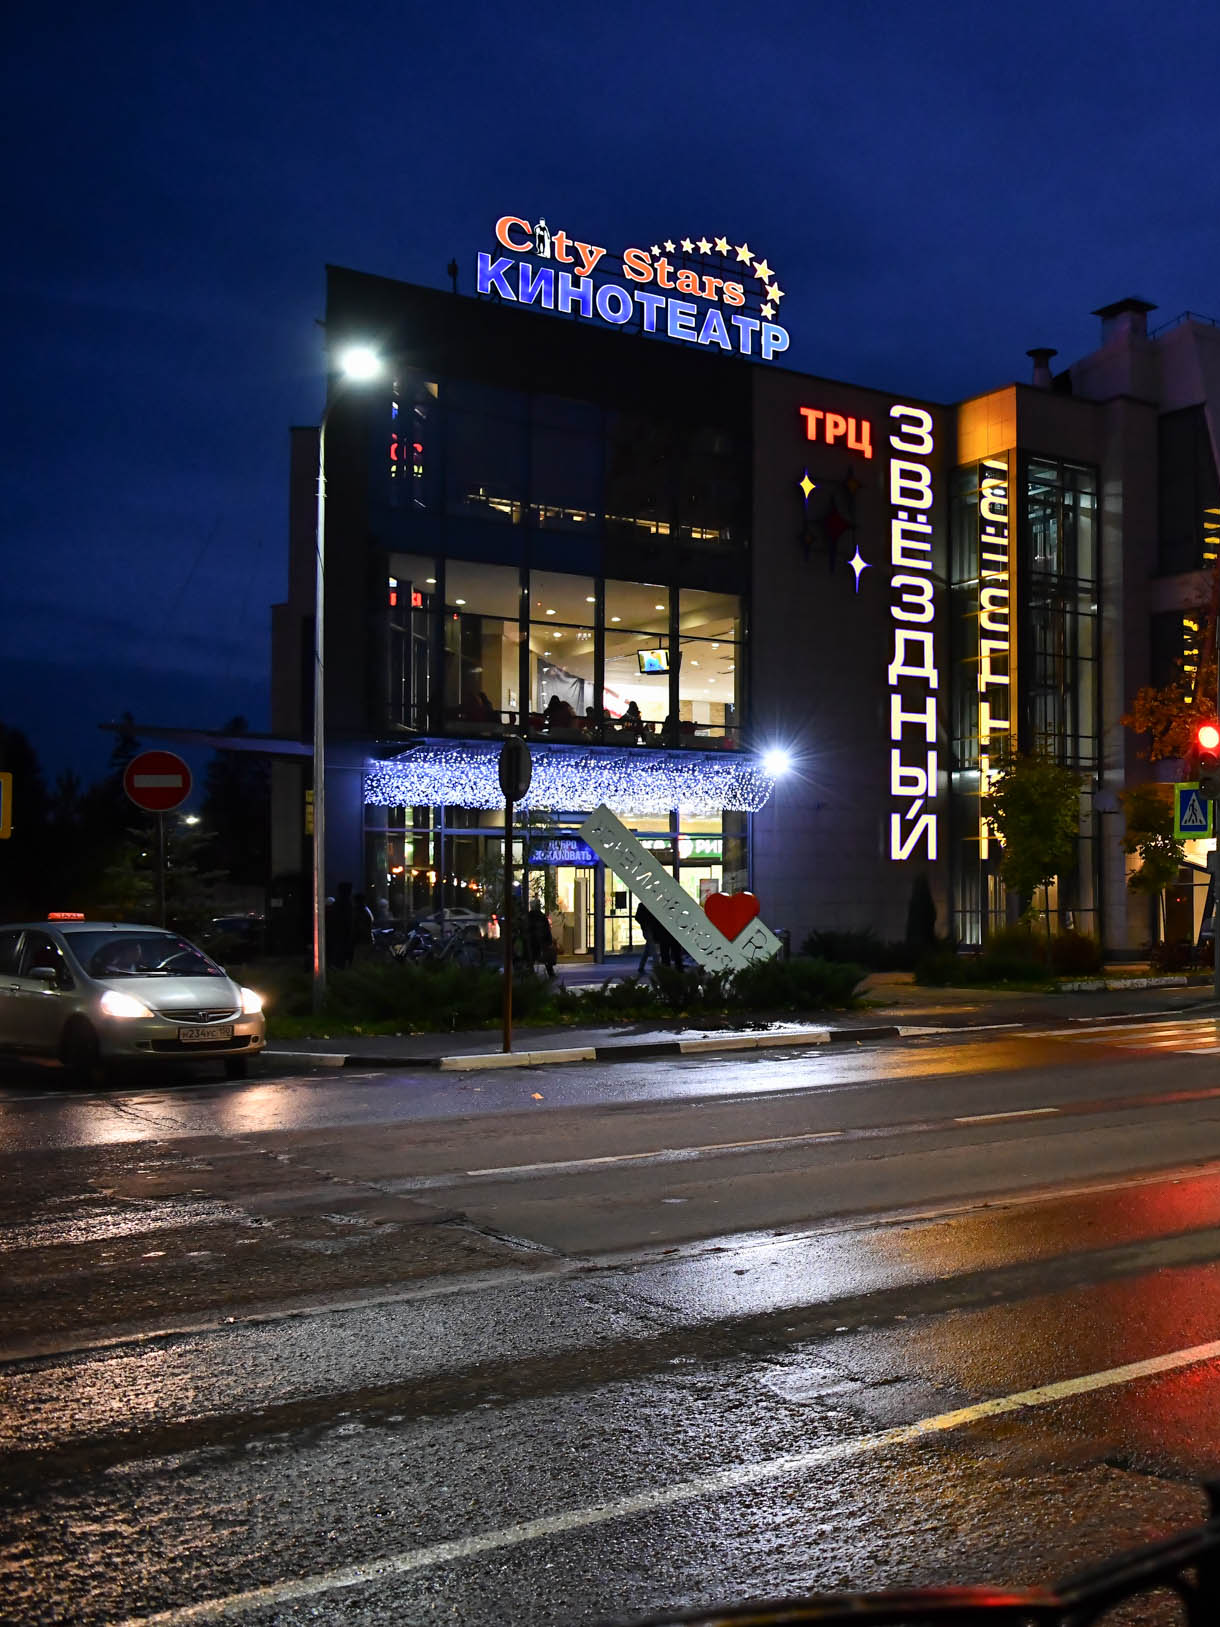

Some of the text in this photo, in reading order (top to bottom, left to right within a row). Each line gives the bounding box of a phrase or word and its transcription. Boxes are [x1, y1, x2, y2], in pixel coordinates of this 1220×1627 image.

[476, 251, 790, 361] КИНОТЕАТР
[623, 248, 746, 307] Stars
[800, 406, 873, 459] ТРЦ
[888, 404, 938, 861] ЗВЁЗДНЫЙ
